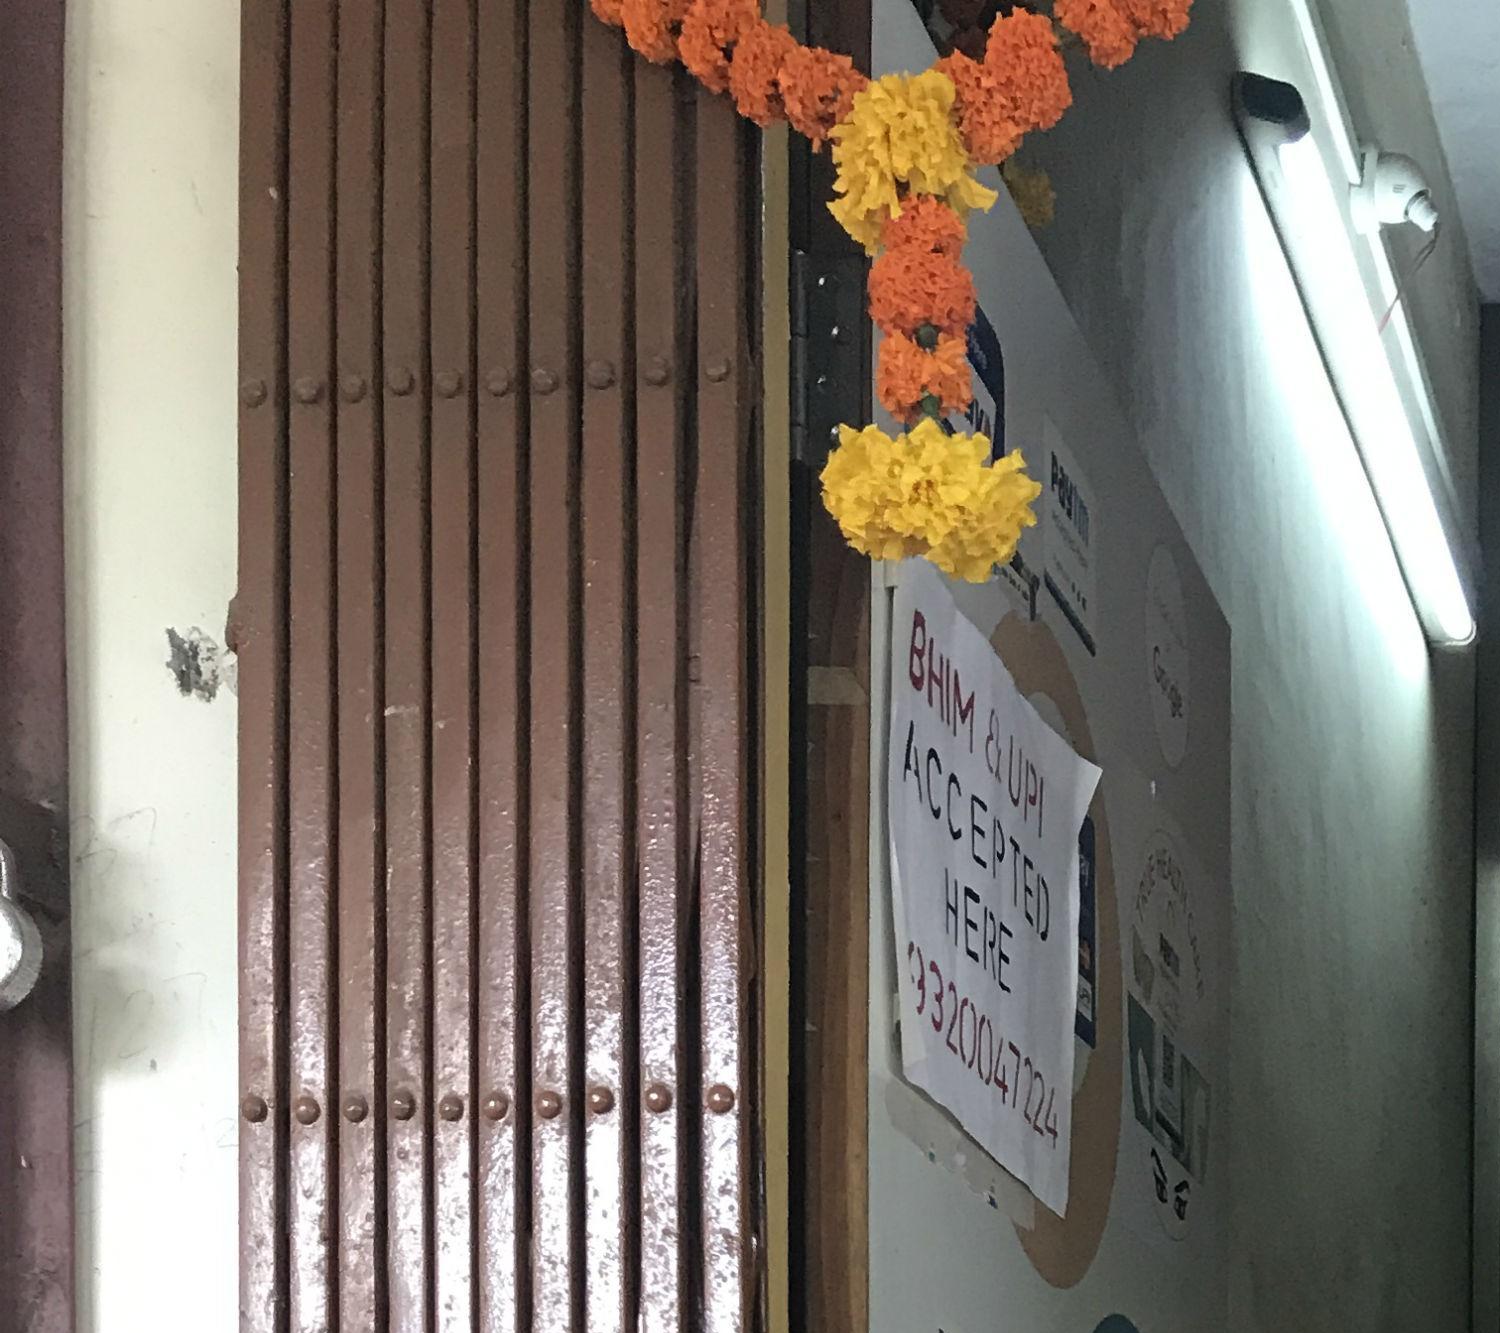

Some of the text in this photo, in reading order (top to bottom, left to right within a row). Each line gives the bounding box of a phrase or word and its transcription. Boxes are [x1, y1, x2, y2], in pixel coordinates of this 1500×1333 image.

[904, 720, 1050, 941] ACCEPTED
[909, 608, 976, 754] BHIM
[1008, 735, 1044, 838] UPI
[945, 867, 1013, 994] HERE
